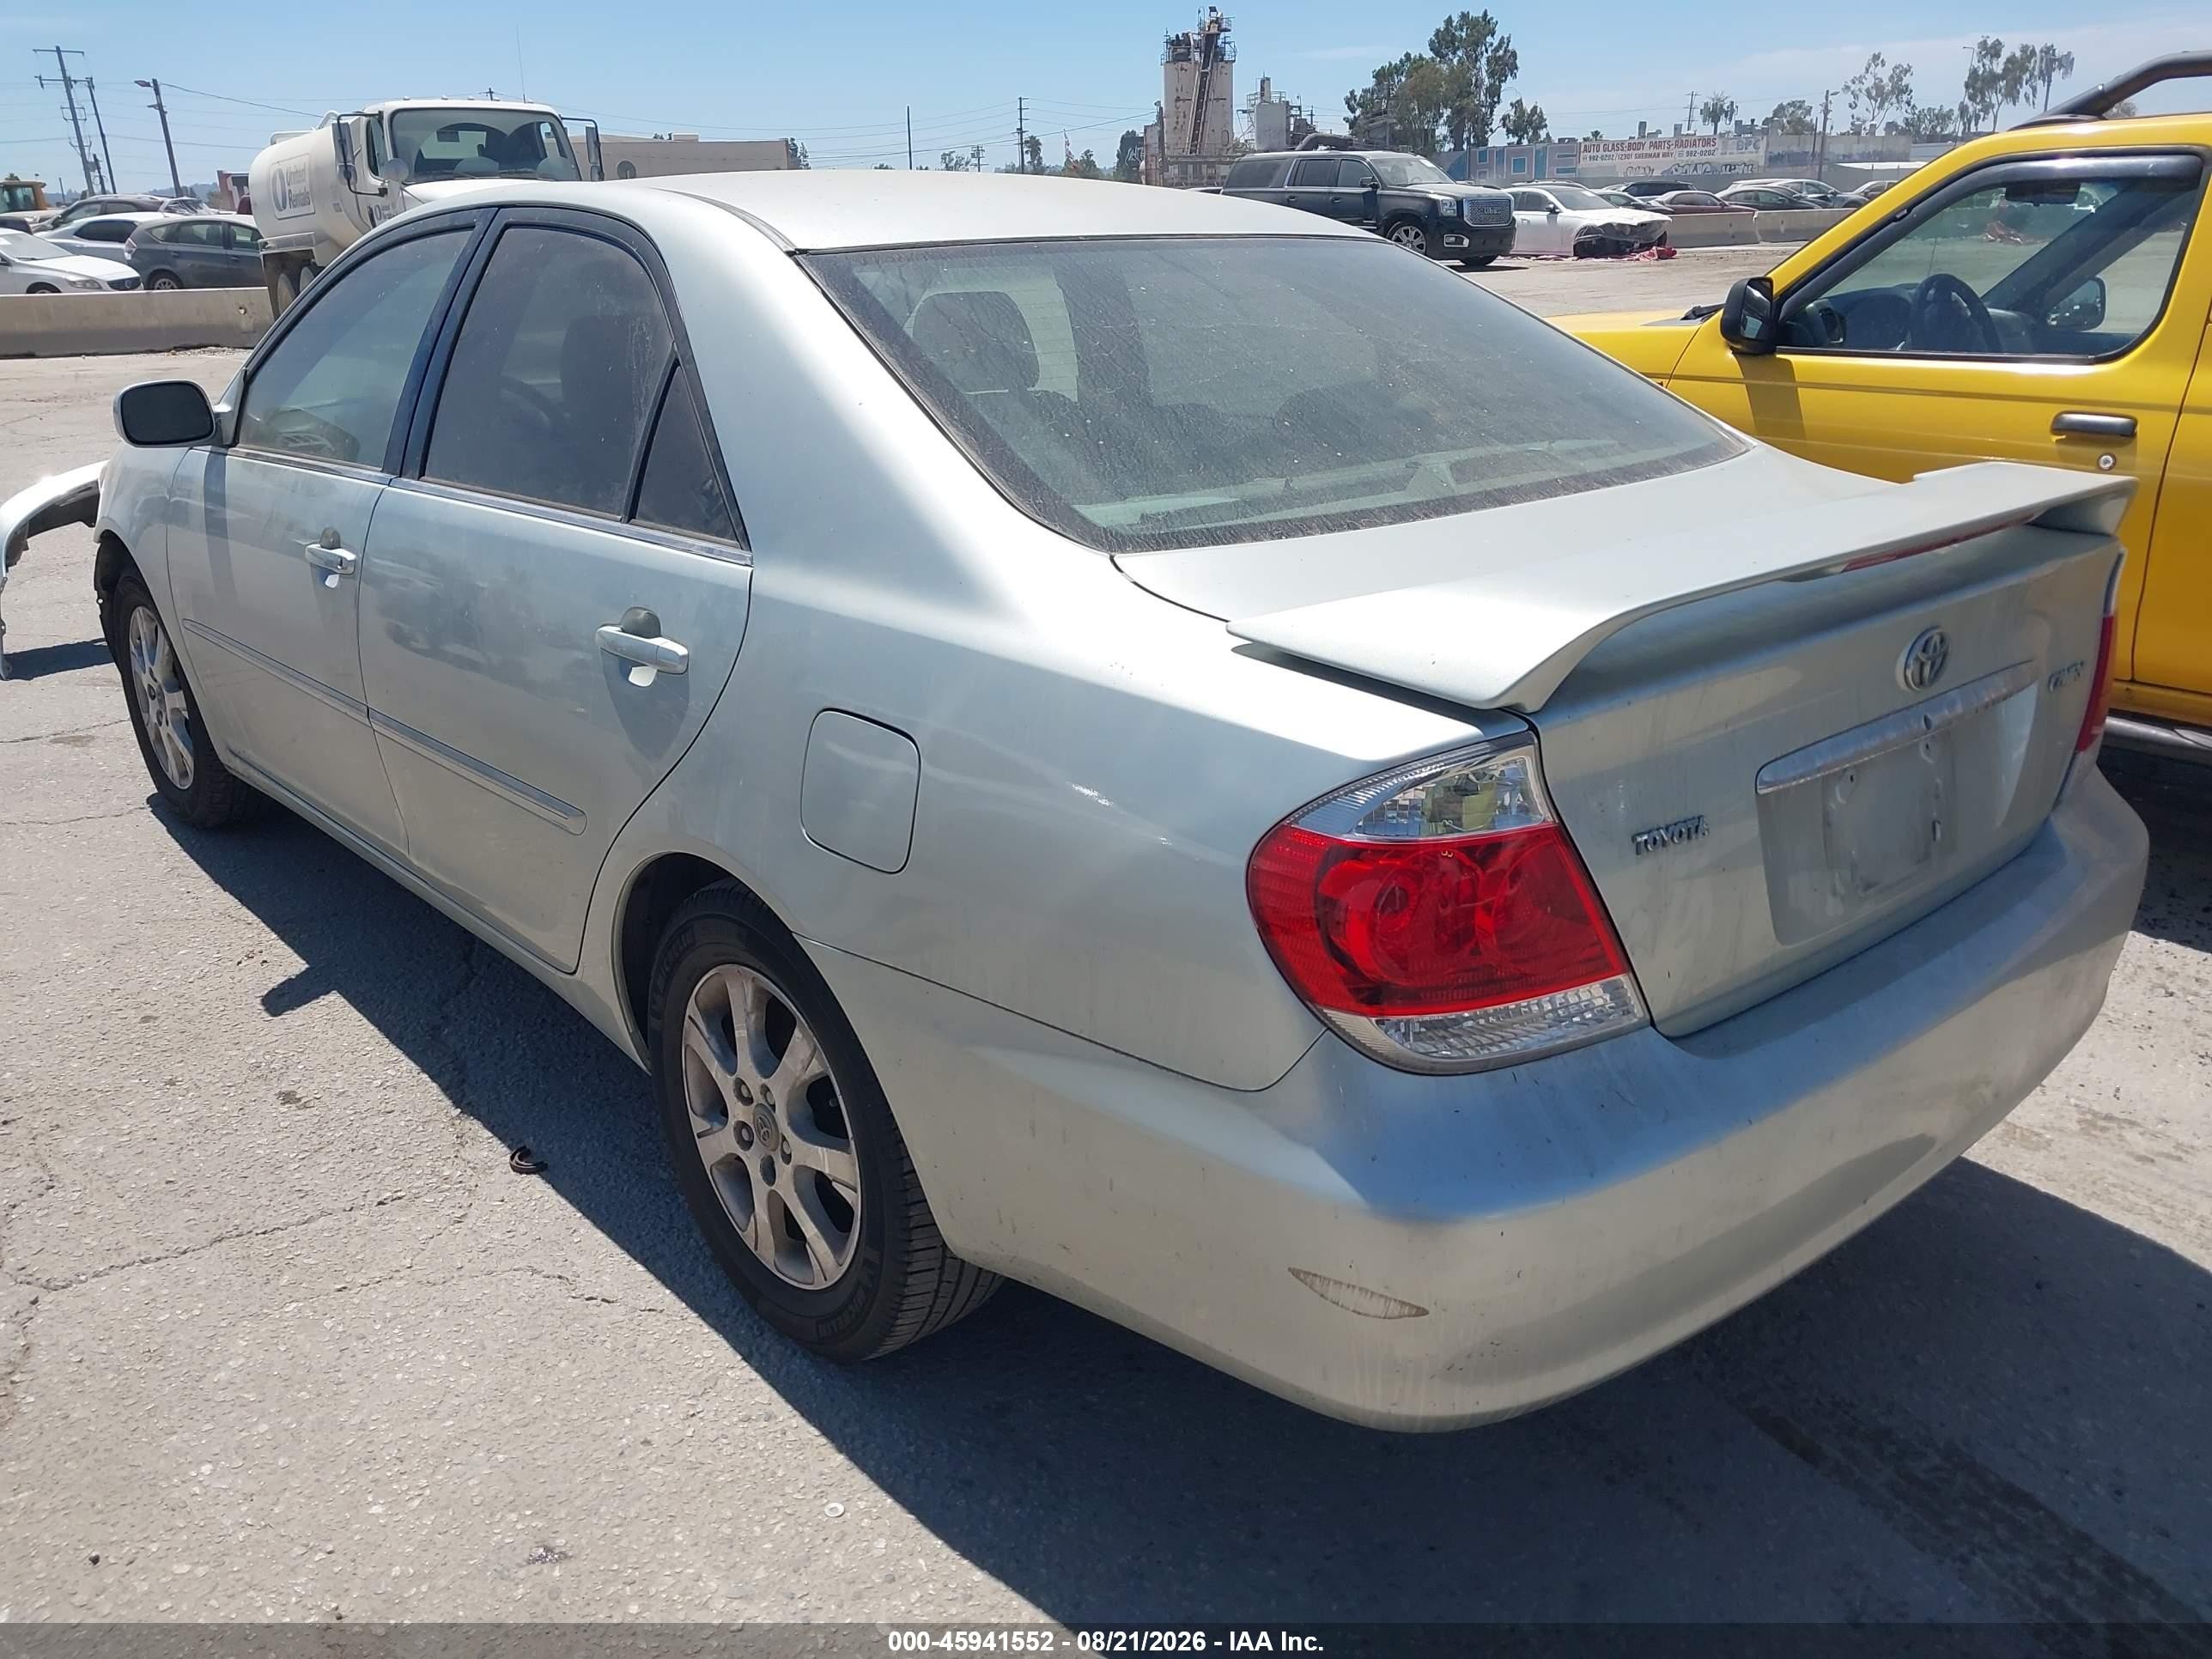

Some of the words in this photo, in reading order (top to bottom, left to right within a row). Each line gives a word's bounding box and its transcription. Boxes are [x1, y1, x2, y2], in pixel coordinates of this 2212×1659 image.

[1583, 143, 1601, 154] AUTO
[1649, 137, 1717, 150] PARTS-RADIATORS
[289, 185, 312, 209] Rentals
[1631, 814, 1711, 856] TOYOTA
